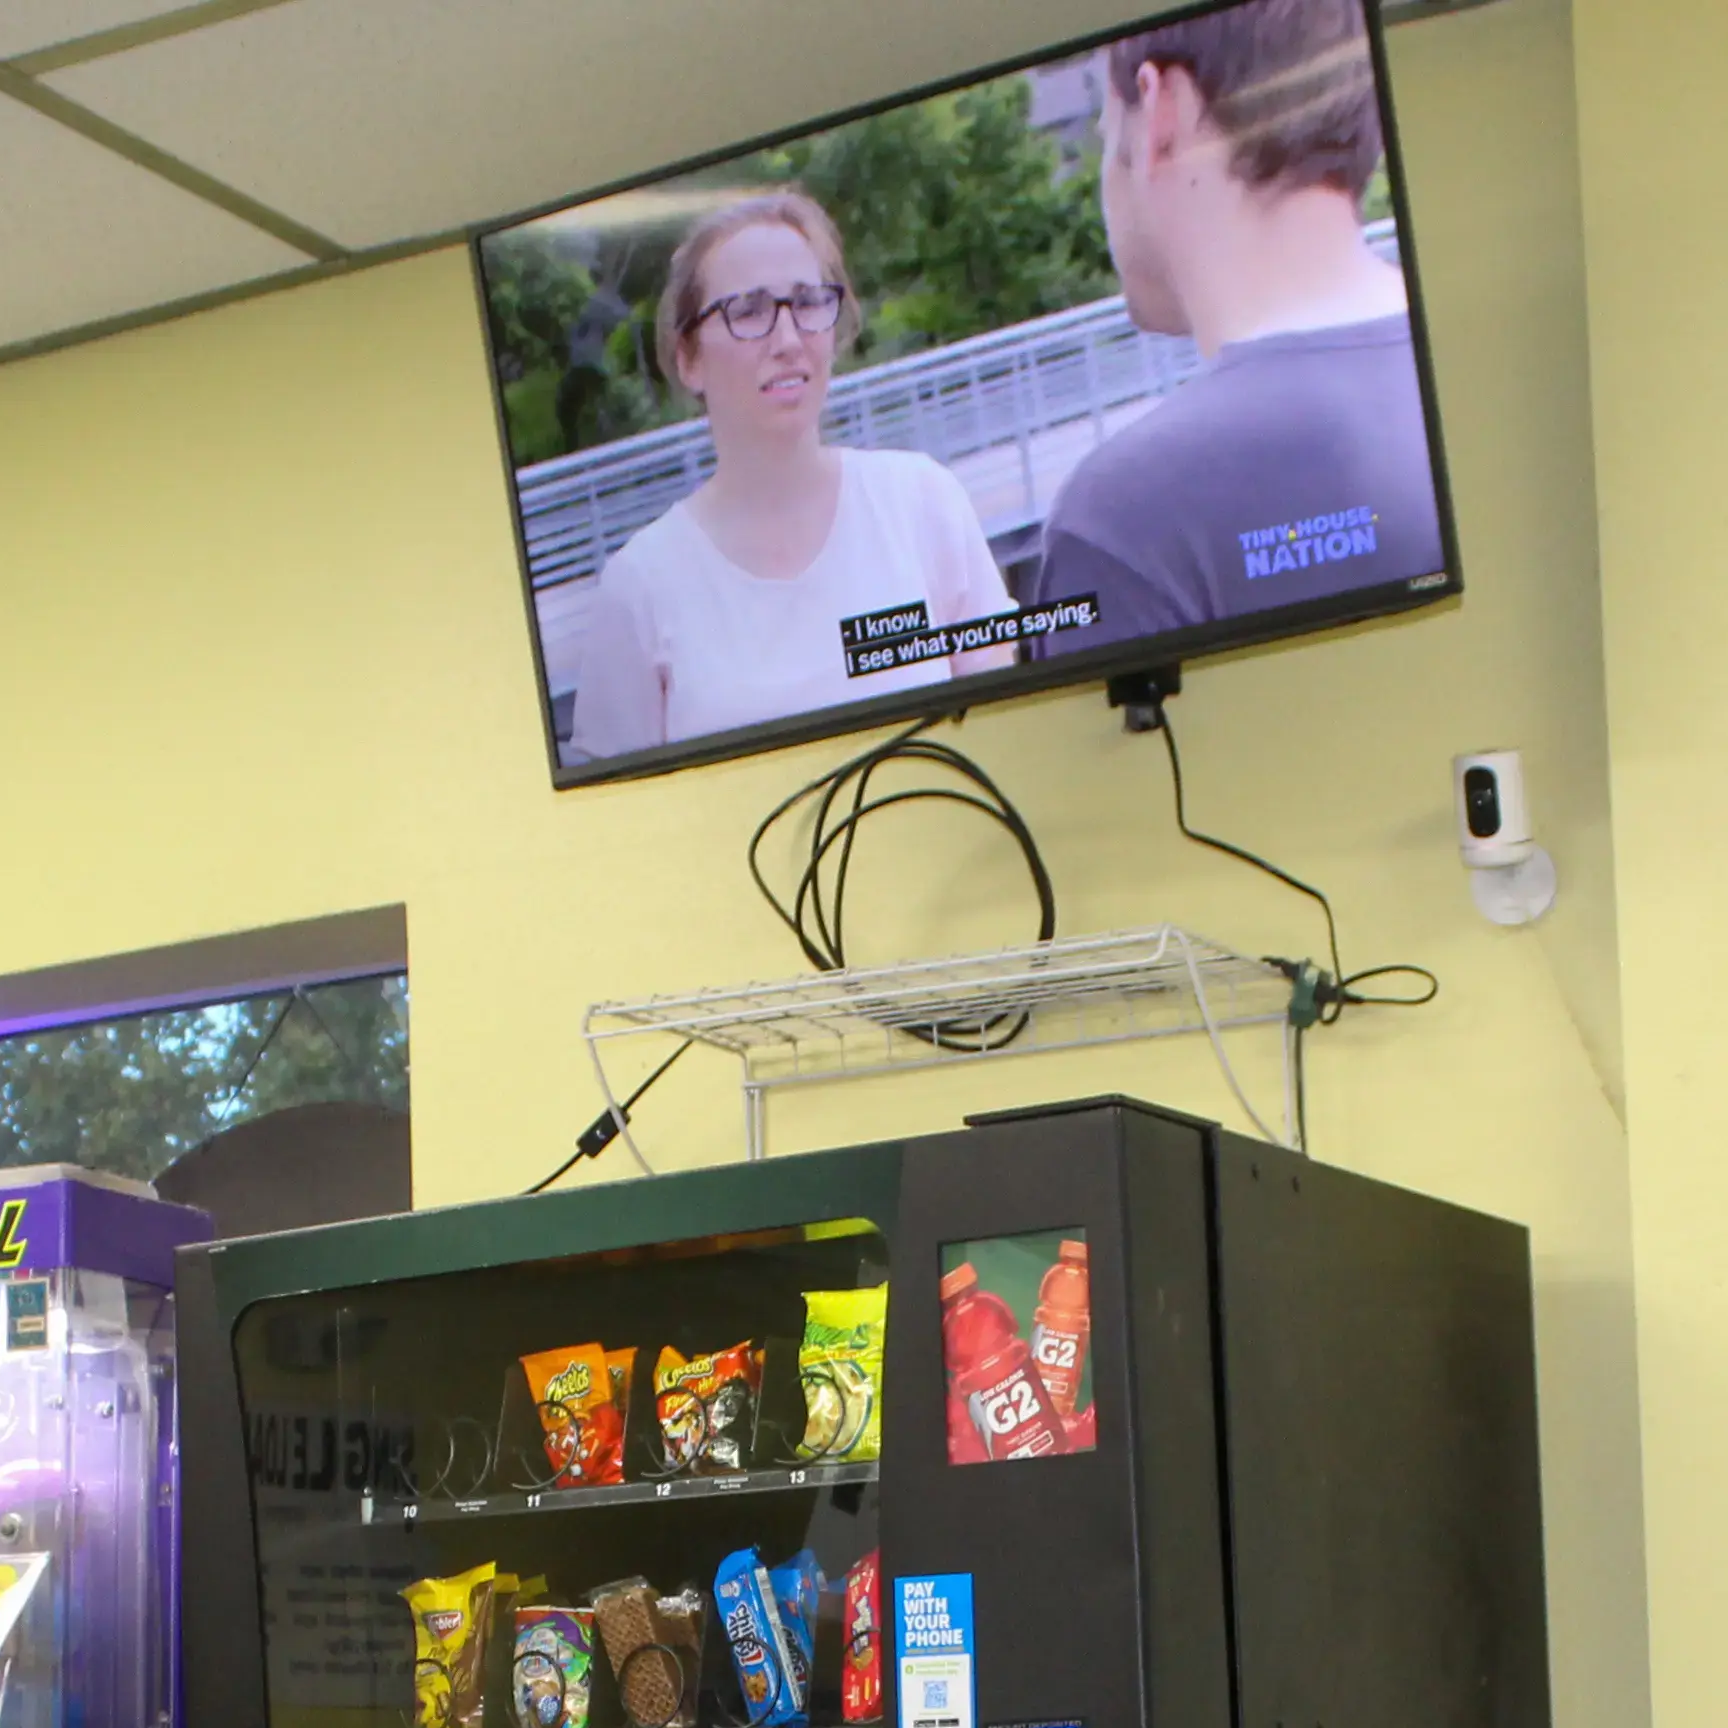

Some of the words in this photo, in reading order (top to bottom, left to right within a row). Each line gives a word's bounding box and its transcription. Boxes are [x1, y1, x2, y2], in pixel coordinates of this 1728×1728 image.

[1239, 524, 1290, 550] TINY
[1295, 506, 1371, 538] HOUSE
[1244, 526, 1377, 579] NATION
[866, 609, 927, 638] know.
[858, 649, 893, 671] see
[898, 636, 949, 662] what
[952, 619, 1018, 655] you're
[1021, 600, 1098, 633] saying.
[1038, 1337, 1078, 1368] G2
[546, 1365, 590, 1402] Cheetos
[985, 1380, 1042, 1434] G2
[789, 1471, 805, 1485] 13
[656, 1483, 671, 1497] 12
[526, 1494, 540, 1508] 11
[403, 1505, 417, 1518] 10
[904, 1583, 934, 1599] PAY
[904, 1599, 948, 1614] WITH
[904, 1614, 951, 1631] YOUR
[905, 1629, 963, 1648] PHONE
